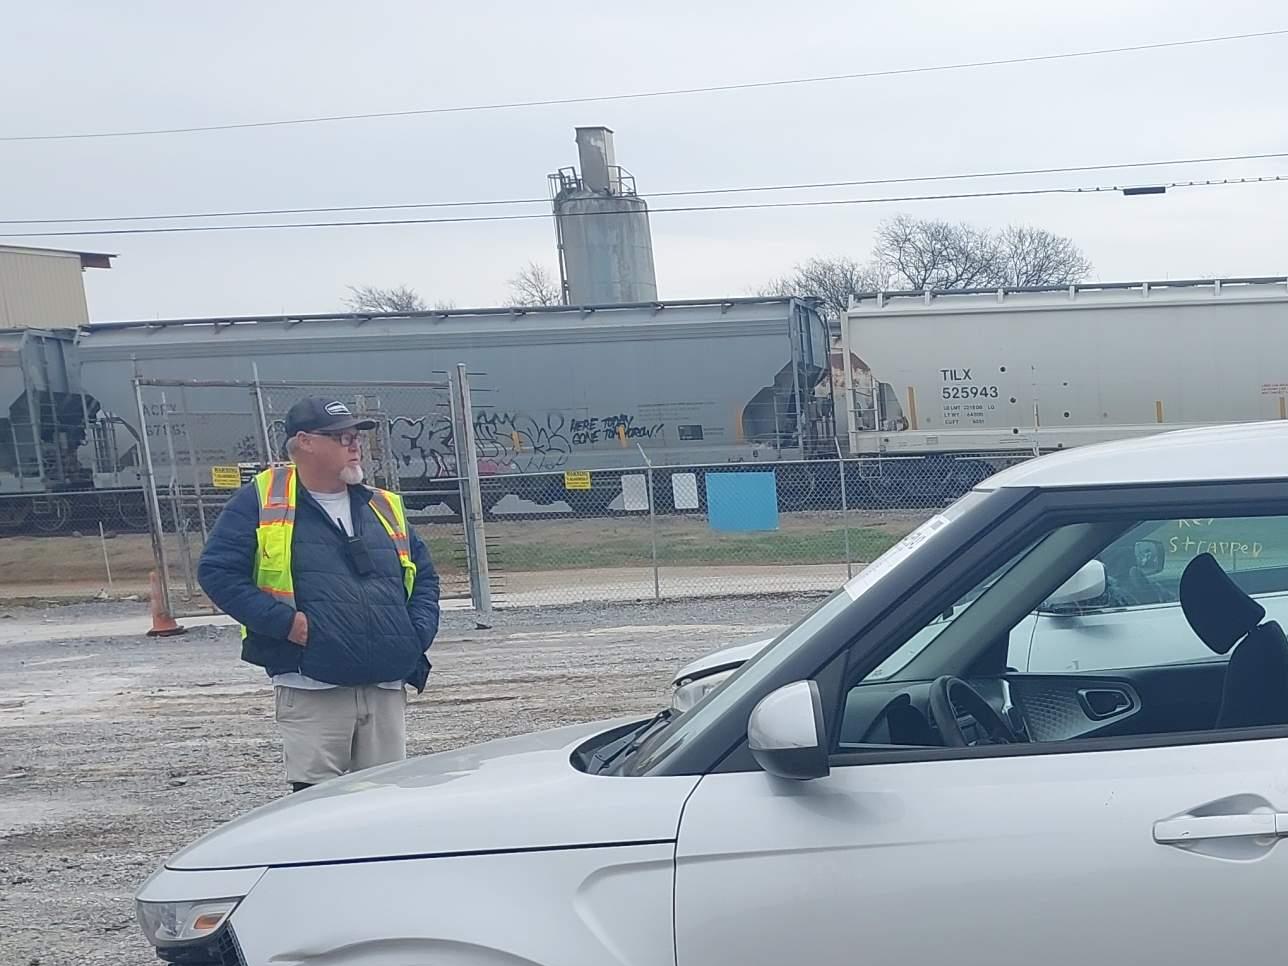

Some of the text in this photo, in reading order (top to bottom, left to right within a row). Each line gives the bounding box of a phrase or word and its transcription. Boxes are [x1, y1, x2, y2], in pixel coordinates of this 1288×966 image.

[940, 369, 972, 381] TILX
[942, 386, 998, 399] 525943
[570, 418, 598, 433] HERE
[572, 429, 600, 445] GONE
